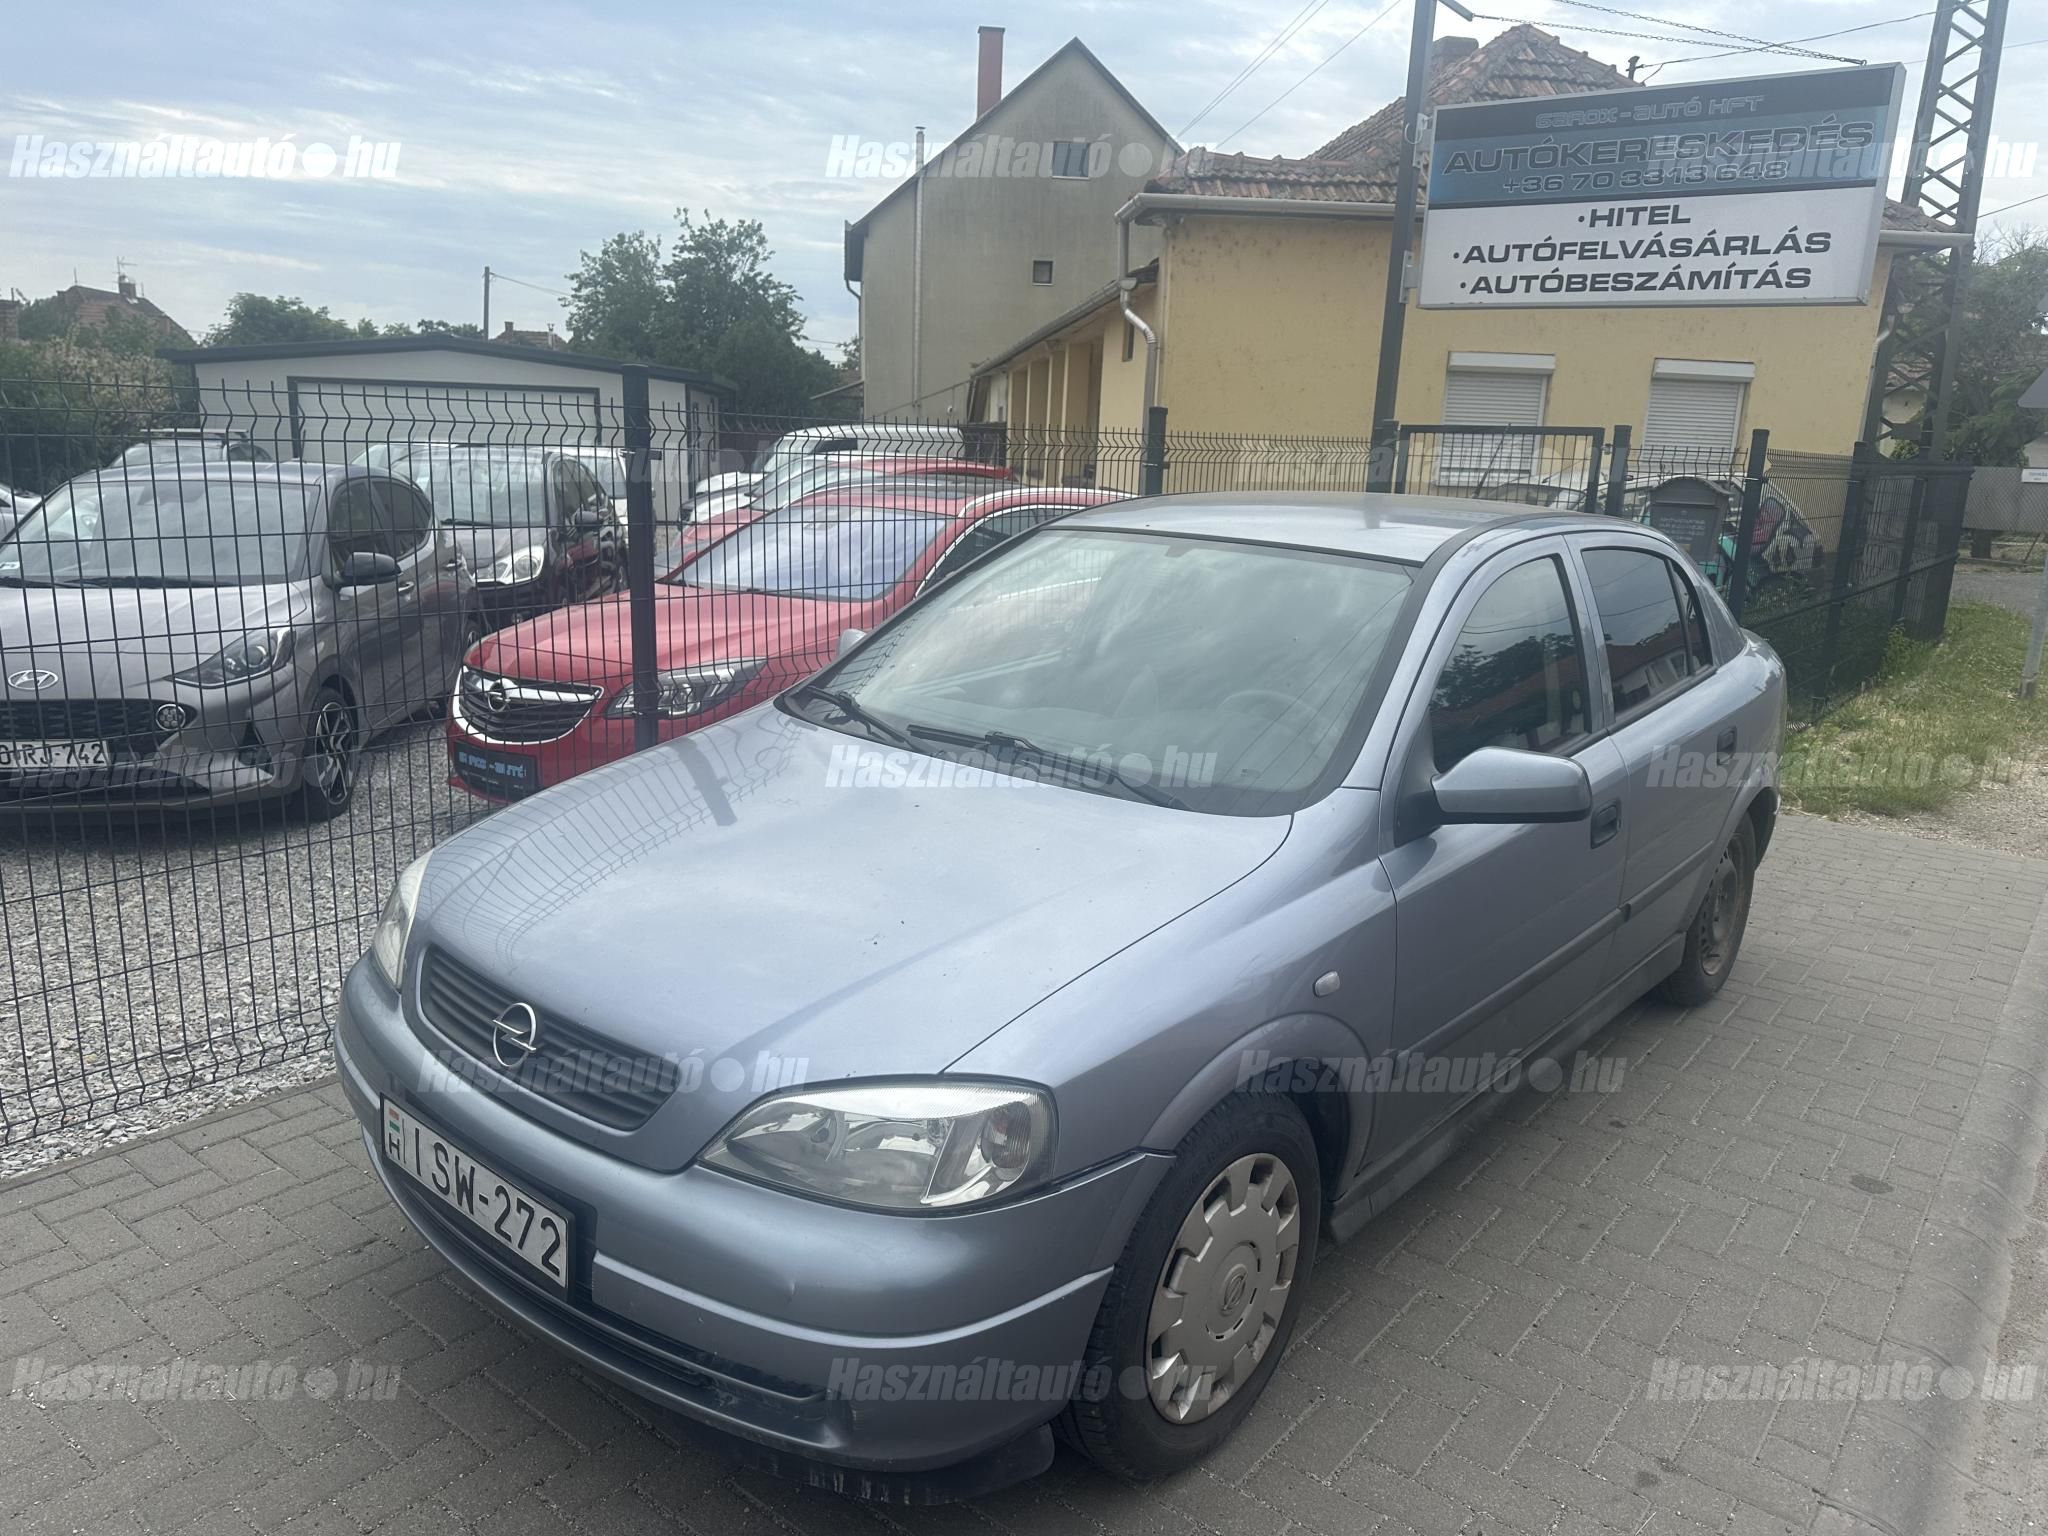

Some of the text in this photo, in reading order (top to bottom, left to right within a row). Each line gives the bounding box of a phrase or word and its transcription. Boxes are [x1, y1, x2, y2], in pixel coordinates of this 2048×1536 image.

[1442, 114, 1875, 176] AUTÓKERESKEDÉS
[1502, 160, 1791, 194] +36 70 3313 648
[1590, 205, 1692, 228] HITEL
[1463, 225, 1832, 264] AUTÓFELVÁSÁRLÁS
[1470, 261, 1813, 295] AUTÓBESZÁMÍTÁS
